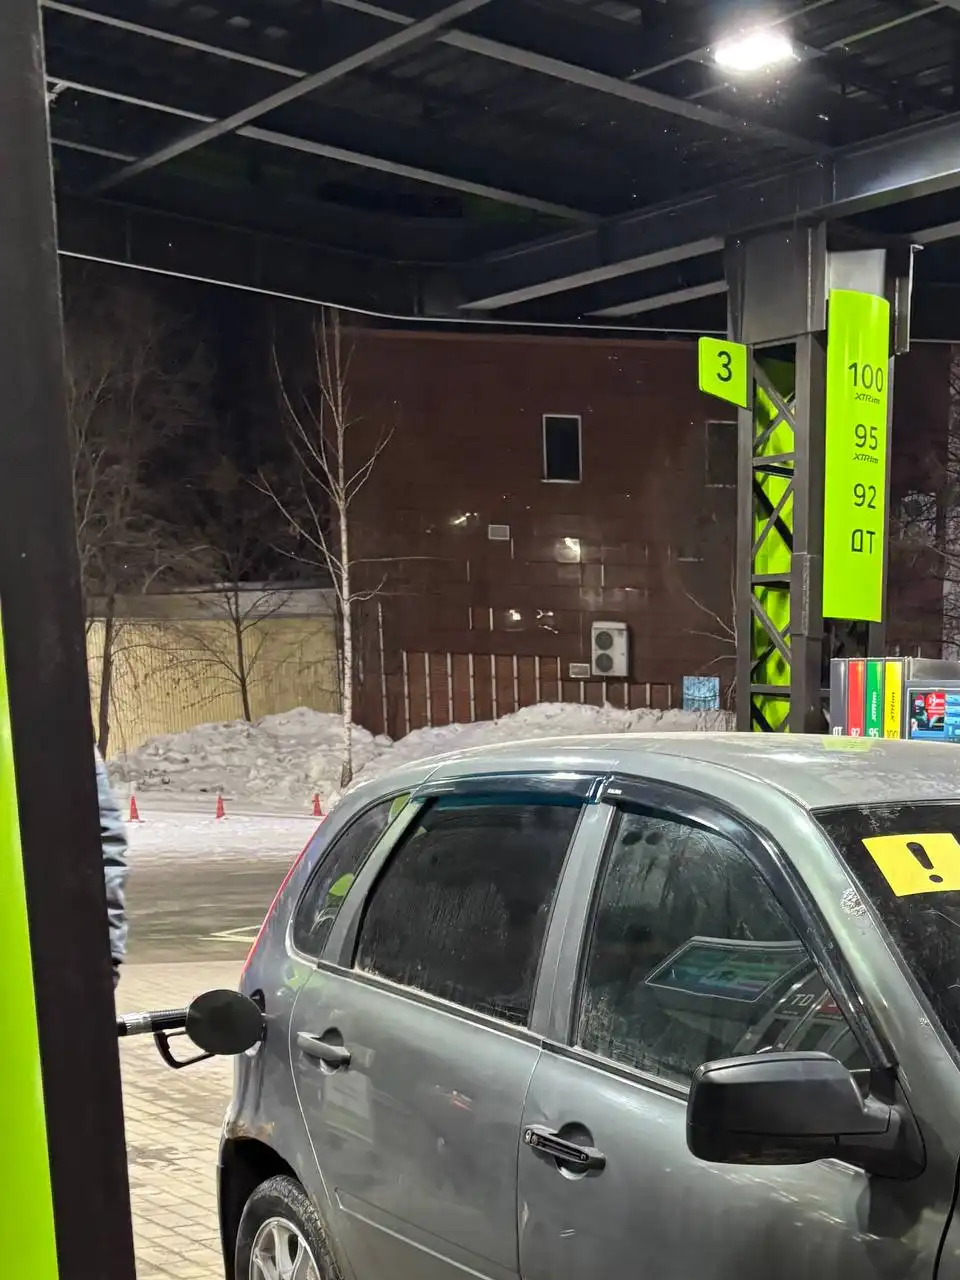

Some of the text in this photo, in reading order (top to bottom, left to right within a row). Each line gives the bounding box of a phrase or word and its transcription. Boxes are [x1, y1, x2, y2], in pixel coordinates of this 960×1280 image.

[717, 350, 732, 382] 3
[848, 362, 884, 392] 100
[855, 424, 878, 450] 95
[853, 483, 876, 509] 92
